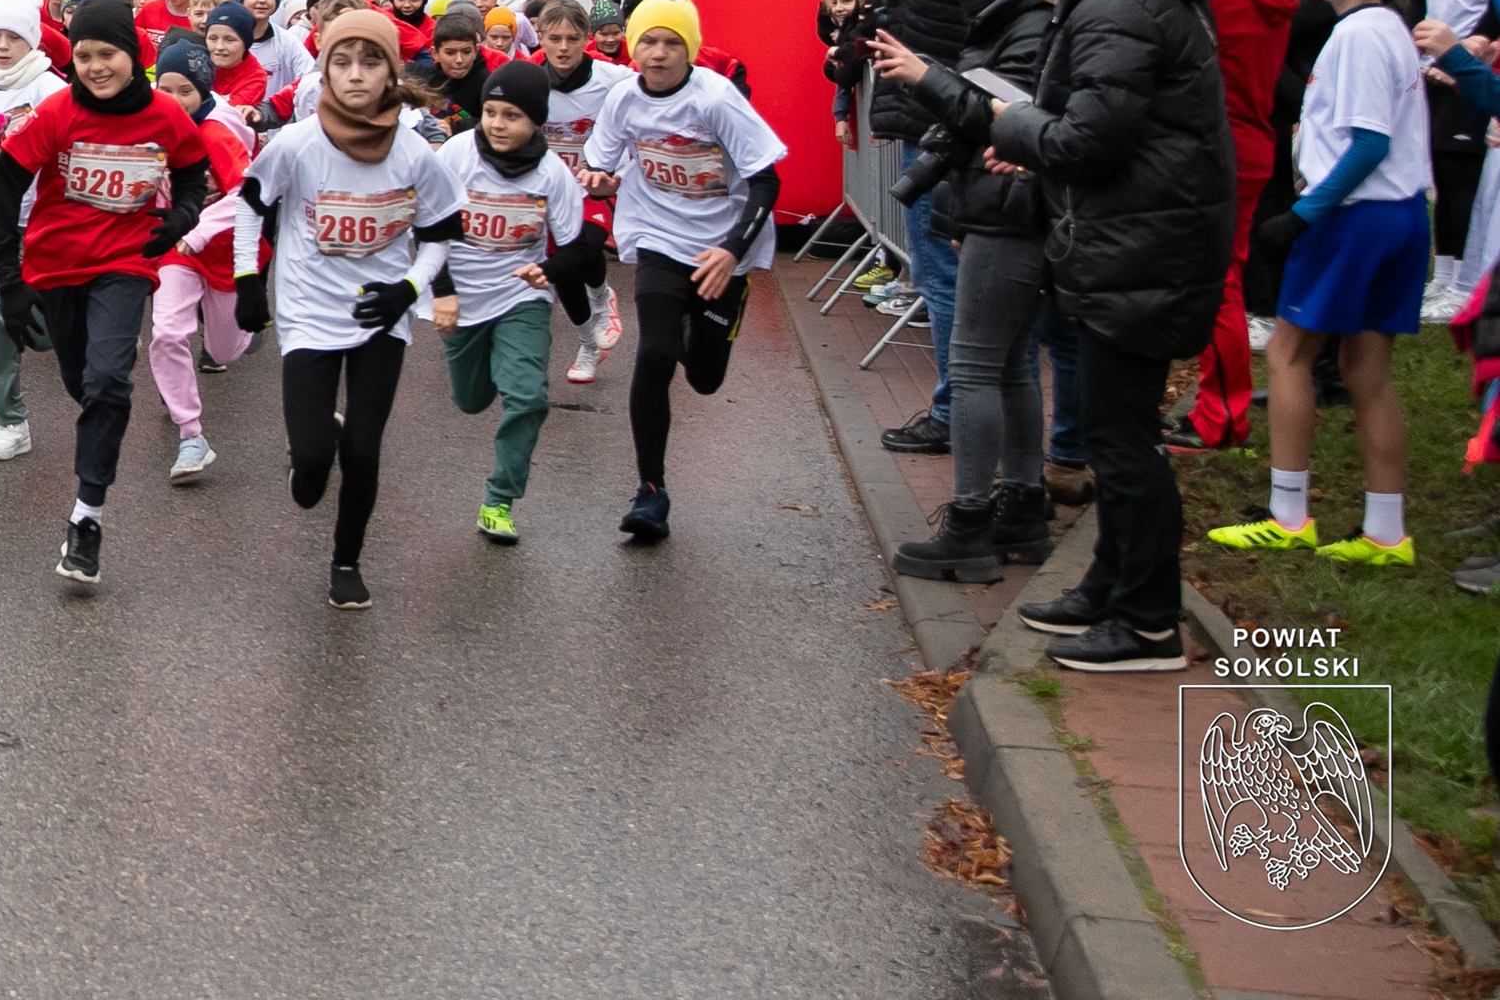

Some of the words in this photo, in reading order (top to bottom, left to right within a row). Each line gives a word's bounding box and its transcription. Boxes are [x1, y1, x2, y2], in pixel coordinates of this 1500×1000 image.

[69, 166, 125, 199] 328
[642, 158, 688, 187] 256
[318, 214, 377, 244] 286
